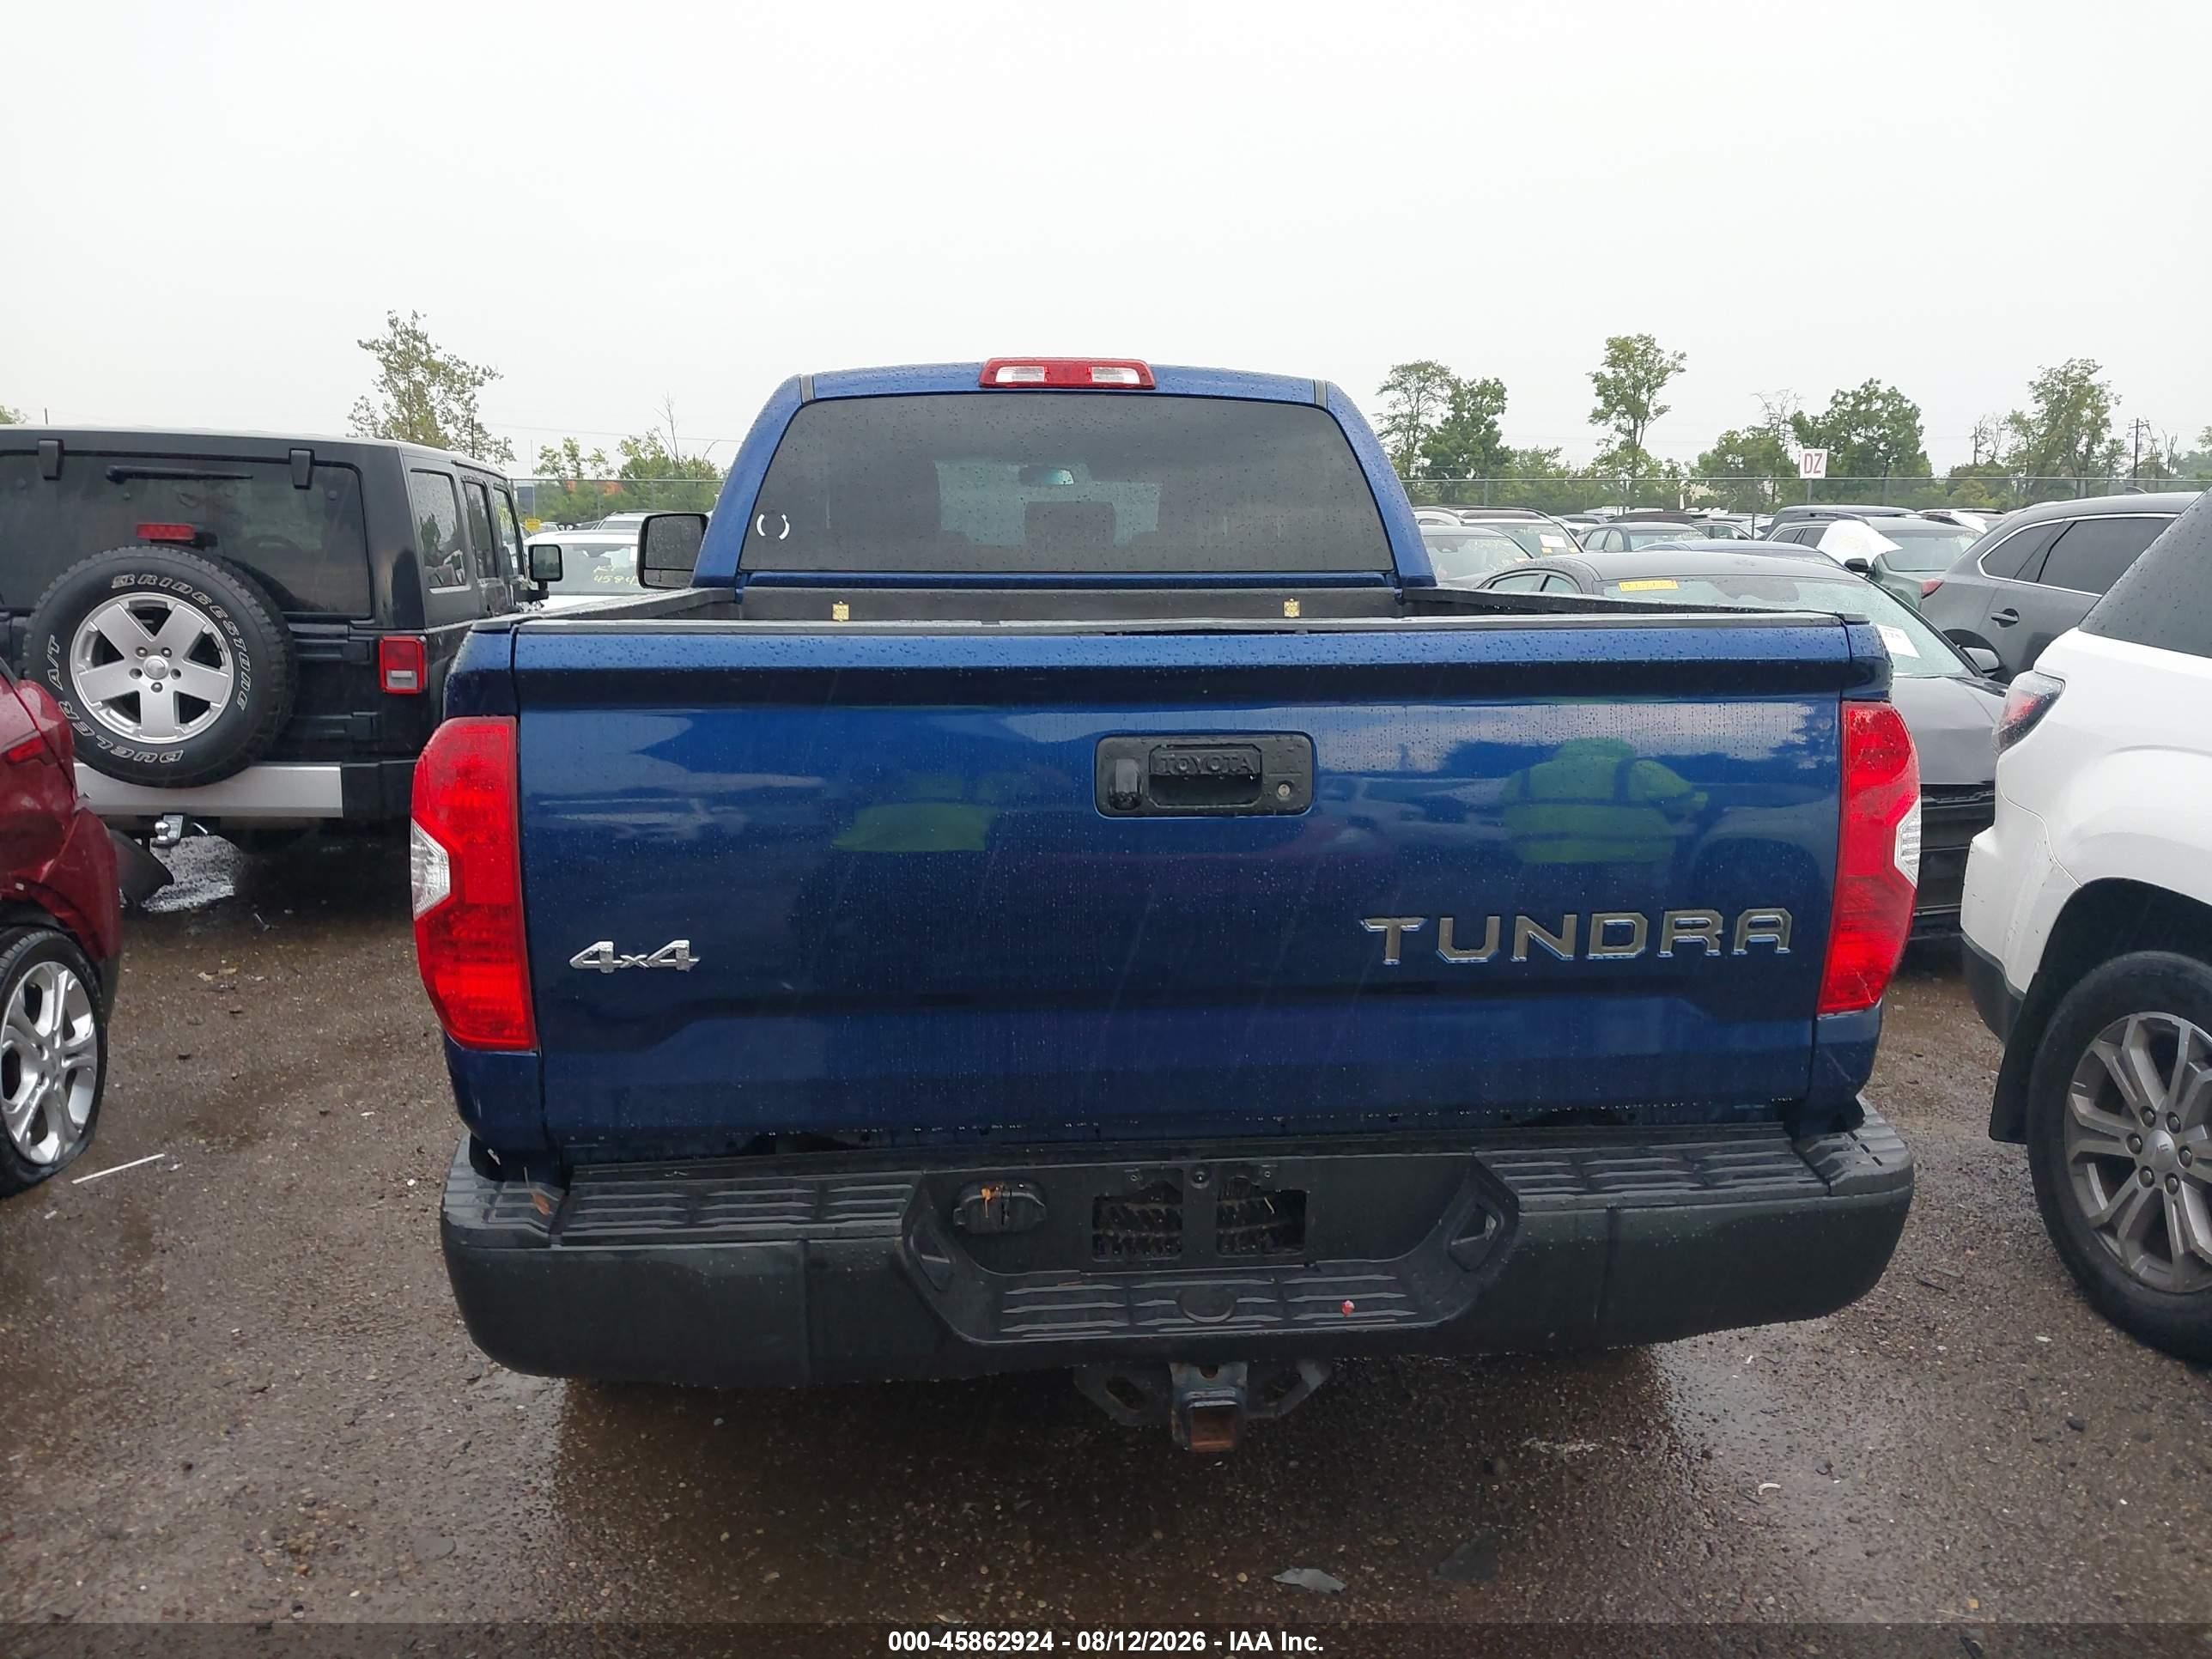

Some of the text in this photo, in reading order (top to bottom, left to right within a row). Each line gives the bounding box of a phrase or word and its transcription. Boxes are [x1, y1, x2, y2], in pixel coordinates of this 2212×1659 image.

[112, 574, 252, 711] BRIDGESTONE
[46, 634, 184, 763] DUELER A/T
[1157, 754, 1256, 775] TOYOTA
[1359, 907, 1793, 965] TUNDRA
